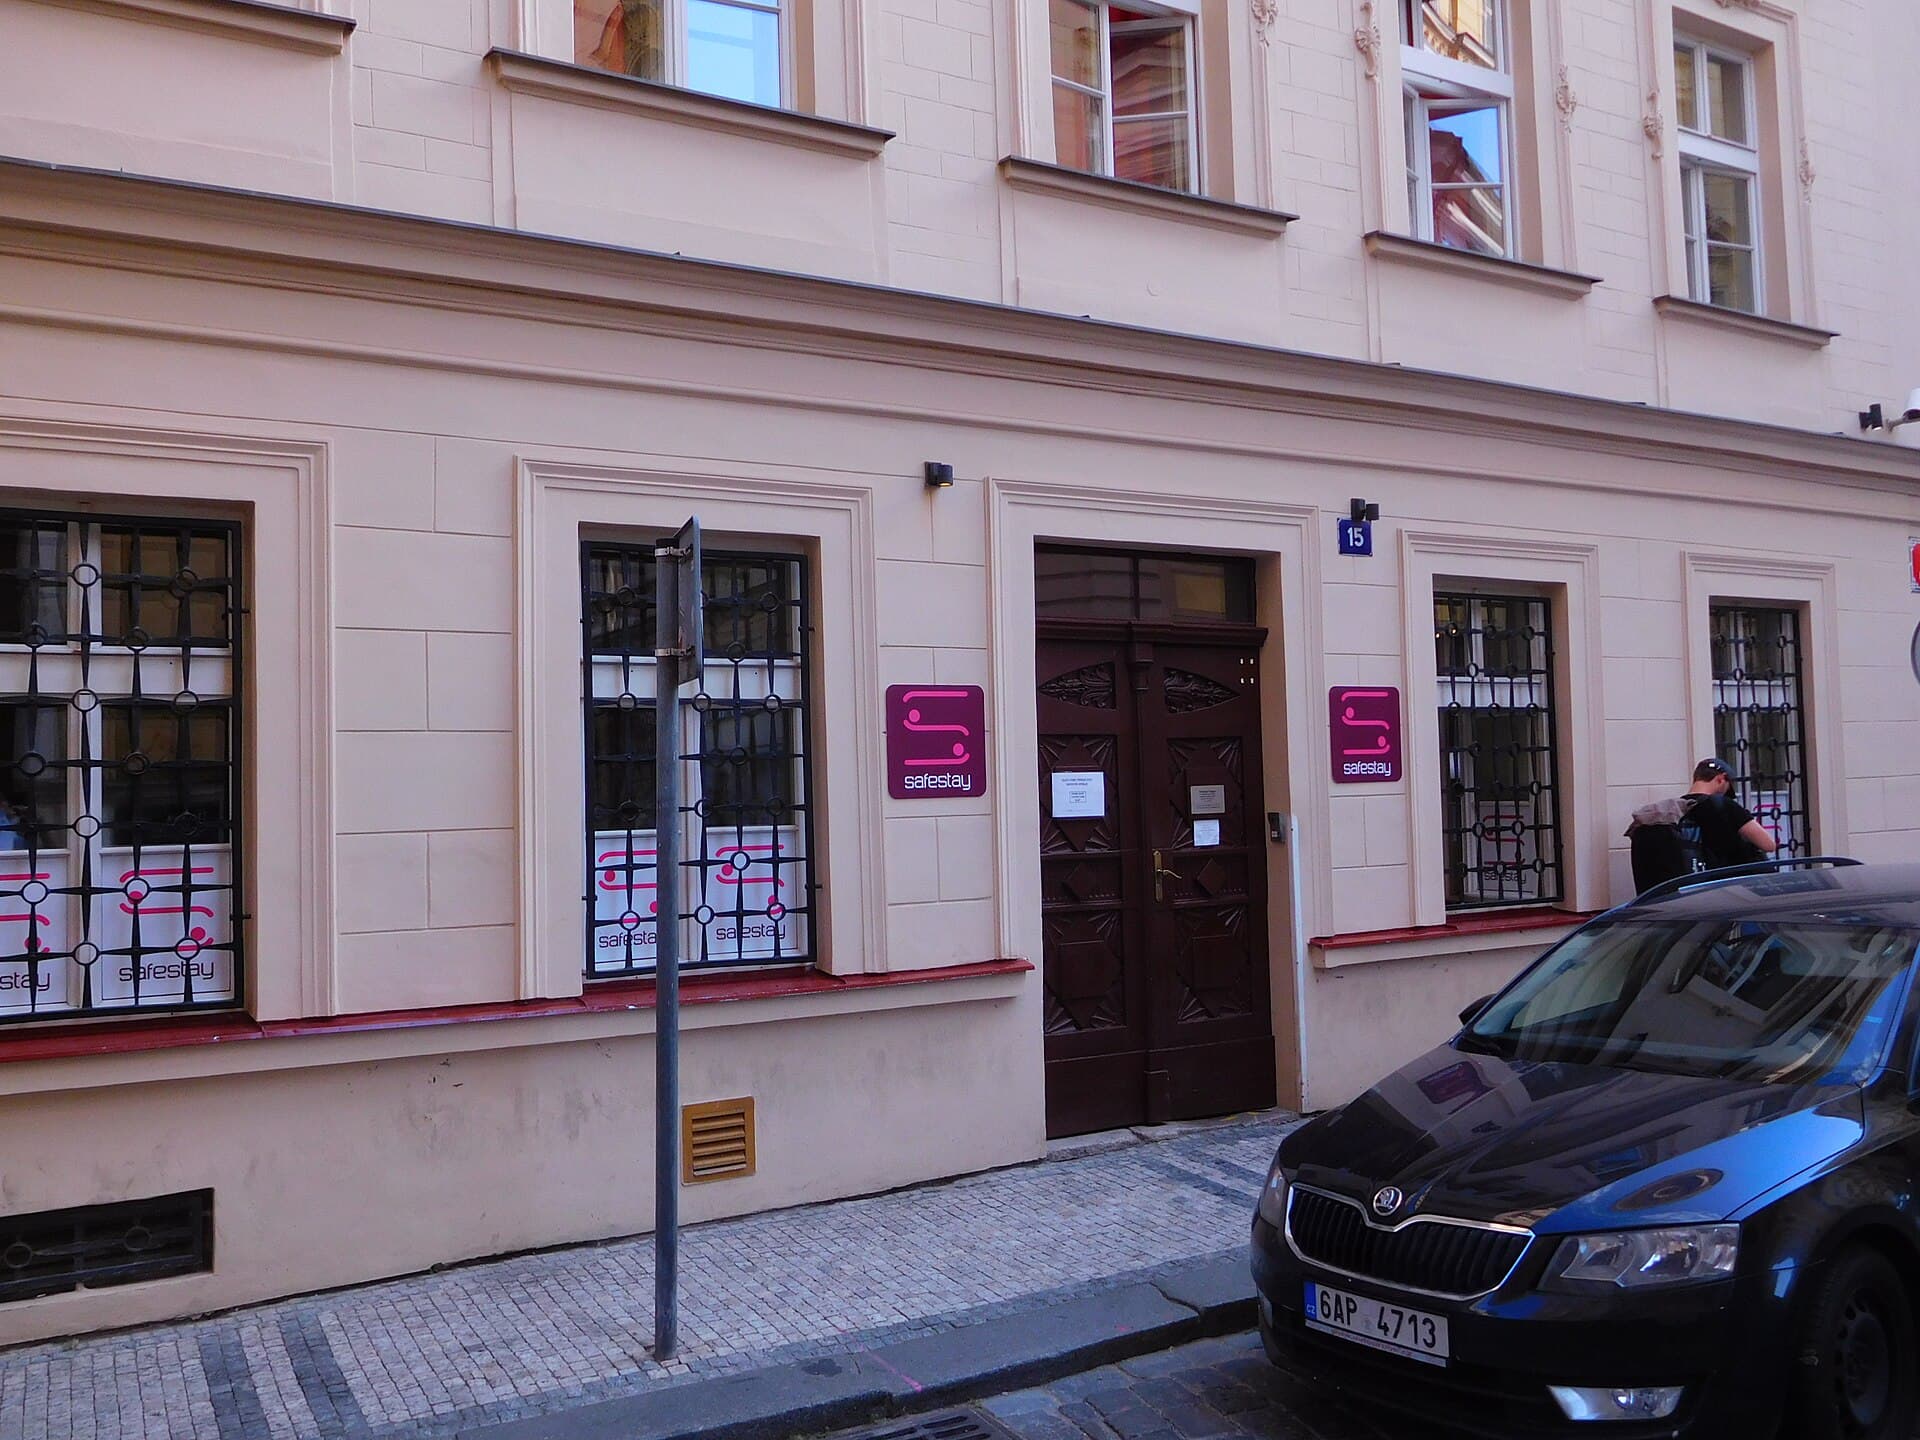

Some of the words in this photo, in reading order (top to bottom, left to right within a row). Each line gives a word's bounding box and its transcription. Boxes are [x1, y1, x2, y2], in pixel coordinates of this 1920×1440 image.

[1347, 527, 1364, 547] 15
[1343, 761, 1391, 776] safestay
[904, 772, 971, 791] safestay
[716, 923, 786, 940] saestay
[1306, 1303, 1316, 1315] CZ
[1319, 1290, 1358, 1326] 6AP
[1377, 1306, 1437, 1349] 4713
